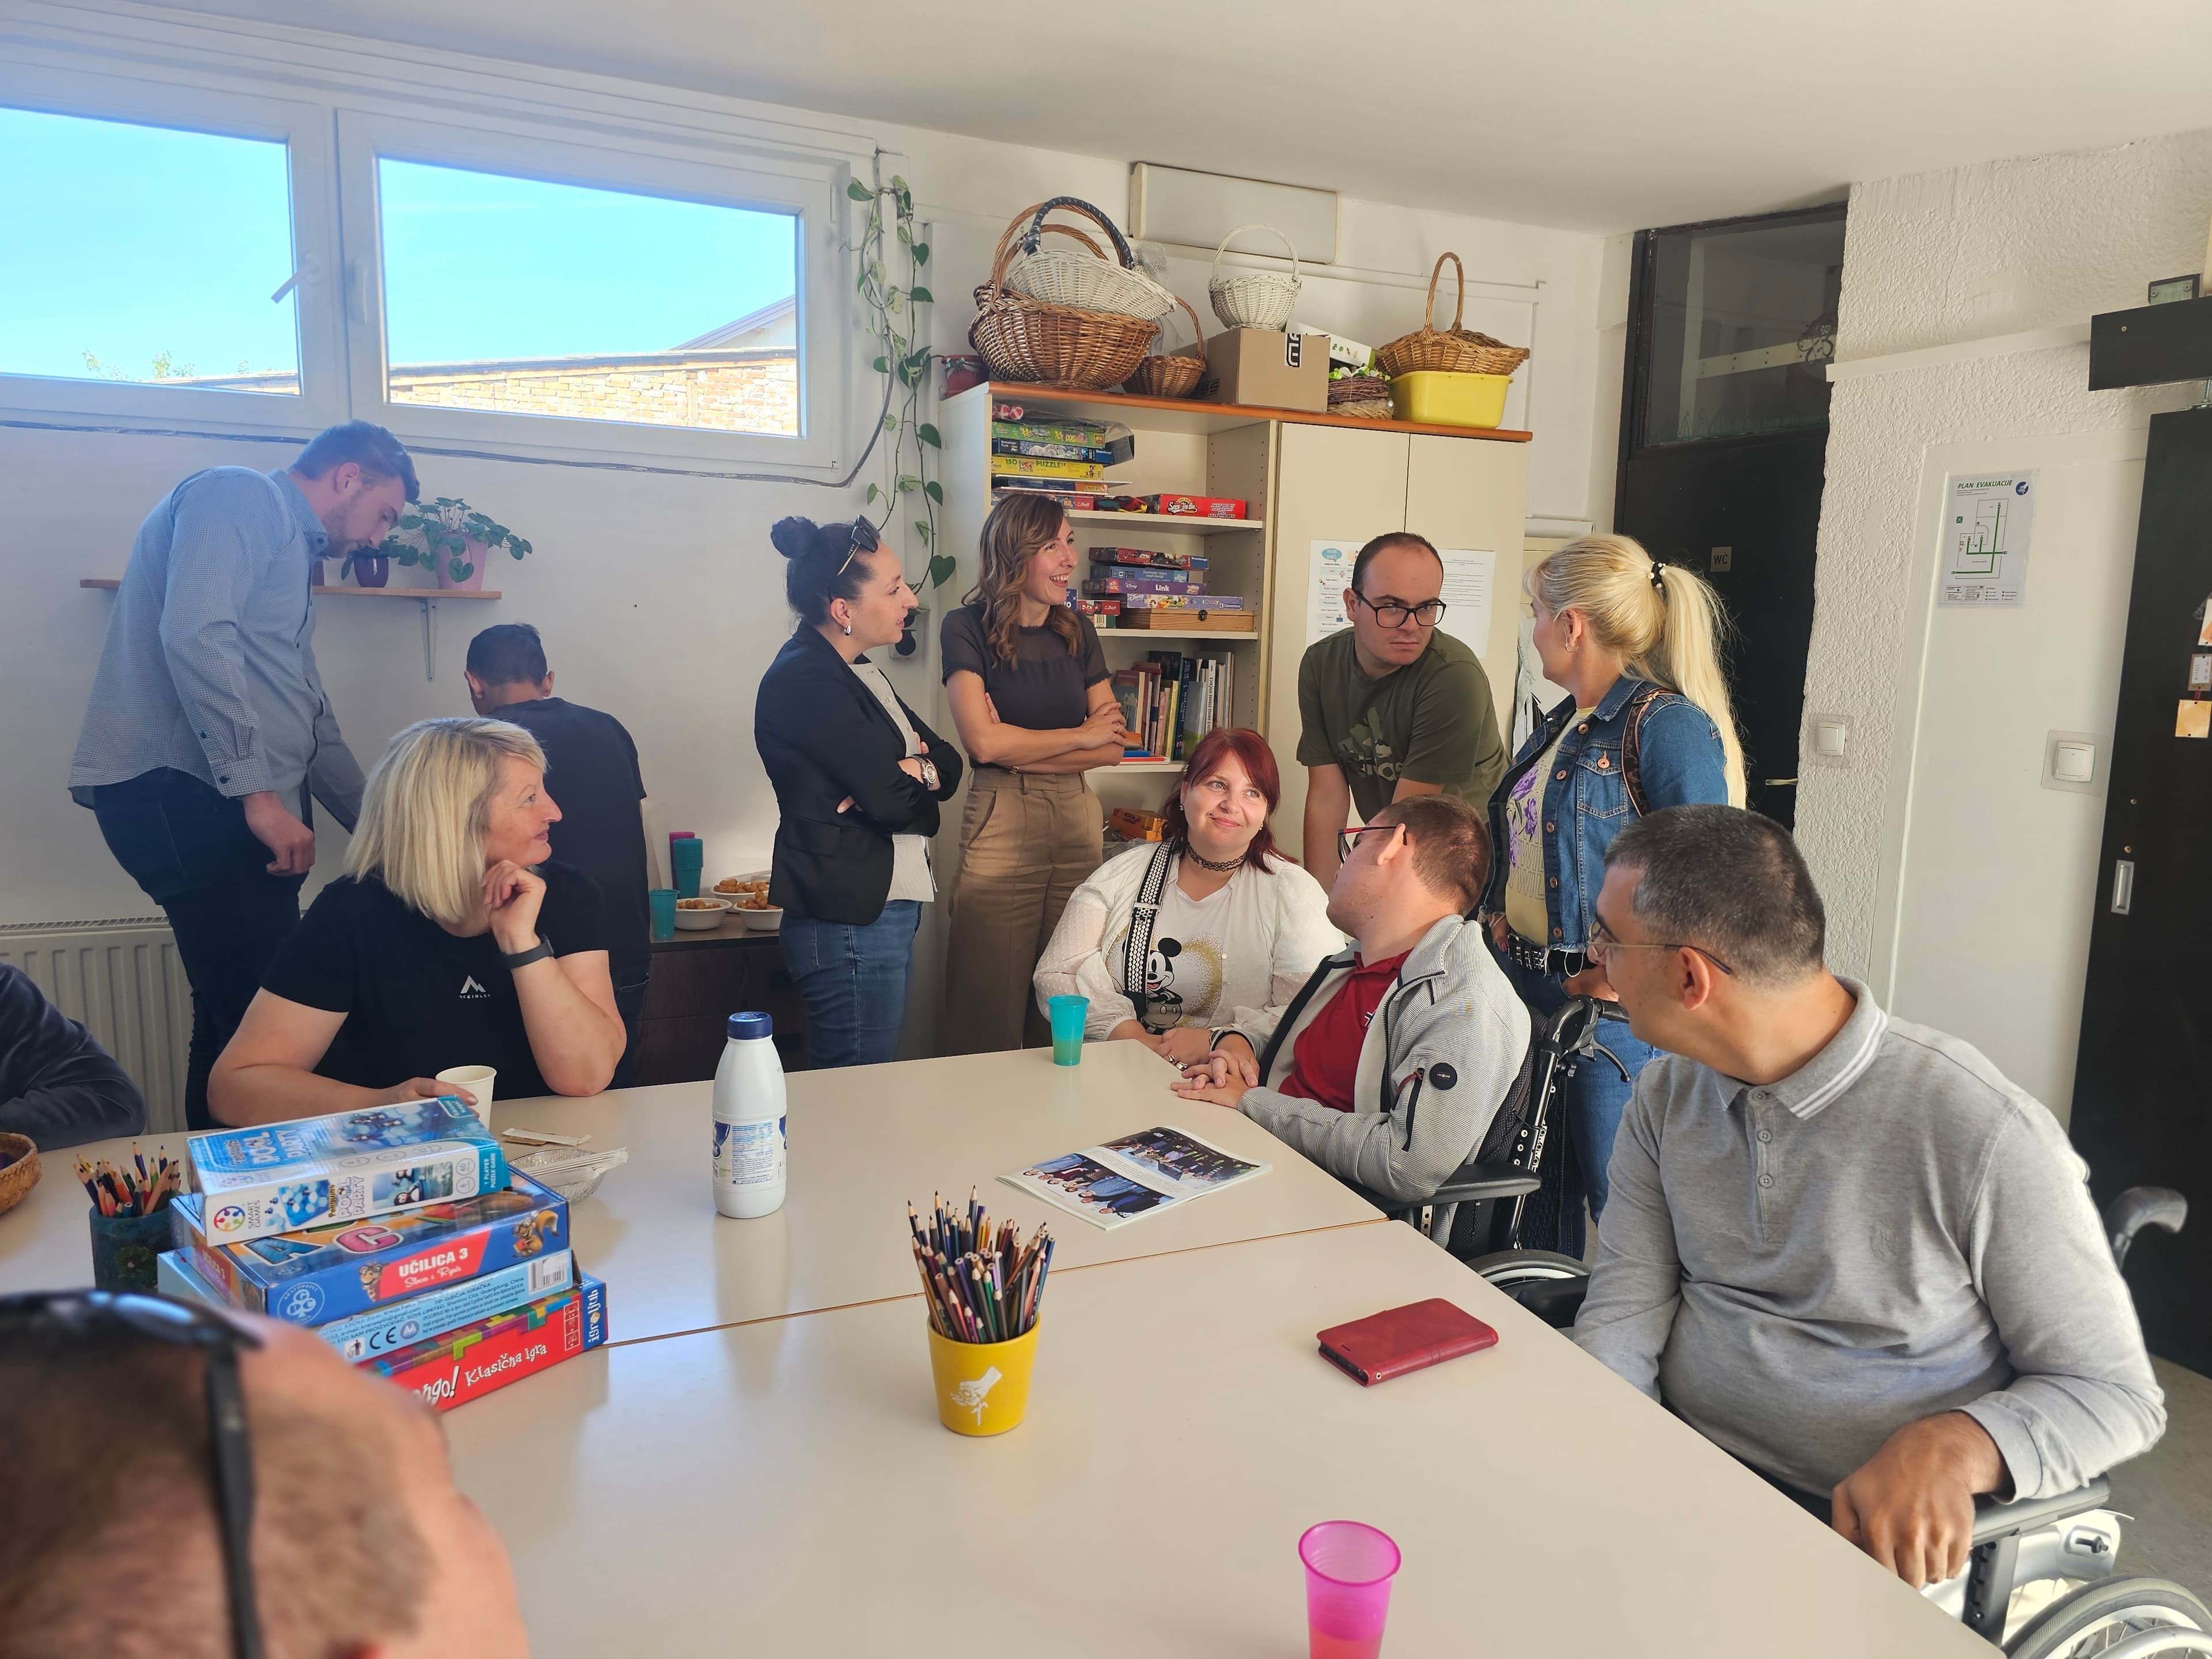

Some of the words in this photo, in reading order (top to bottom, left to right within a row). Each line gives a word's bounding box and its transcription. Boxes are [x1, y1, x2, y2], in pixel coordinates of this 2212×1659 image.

[1036, 460, 1060, 468] PUZZLE
[1976, 480, 2013, 488] EVAKUACIJE
[1714, 554, 1729, 565] WC
[244, 1131, 281, 1164] POOL
[275, 1129, 312, 1158] PARTY
[328, 1184, 336, 1217] Penguins
[336, 1177, 353, 1218] POOL
[353, 1176, 365, 1215] PARTY
[399, 1251, 456, 1277] UČILICA
[459, 1248, 468, 1260] 3
[404, 1277, 429, 1287] Slova
[467, 1282, 491, 1294] IGRAČKA
[413, 1365, 460, 1404] ngo!
[465, 1351, 522, 1387] Klasična
[525, 1343, 547, 1362] igra
